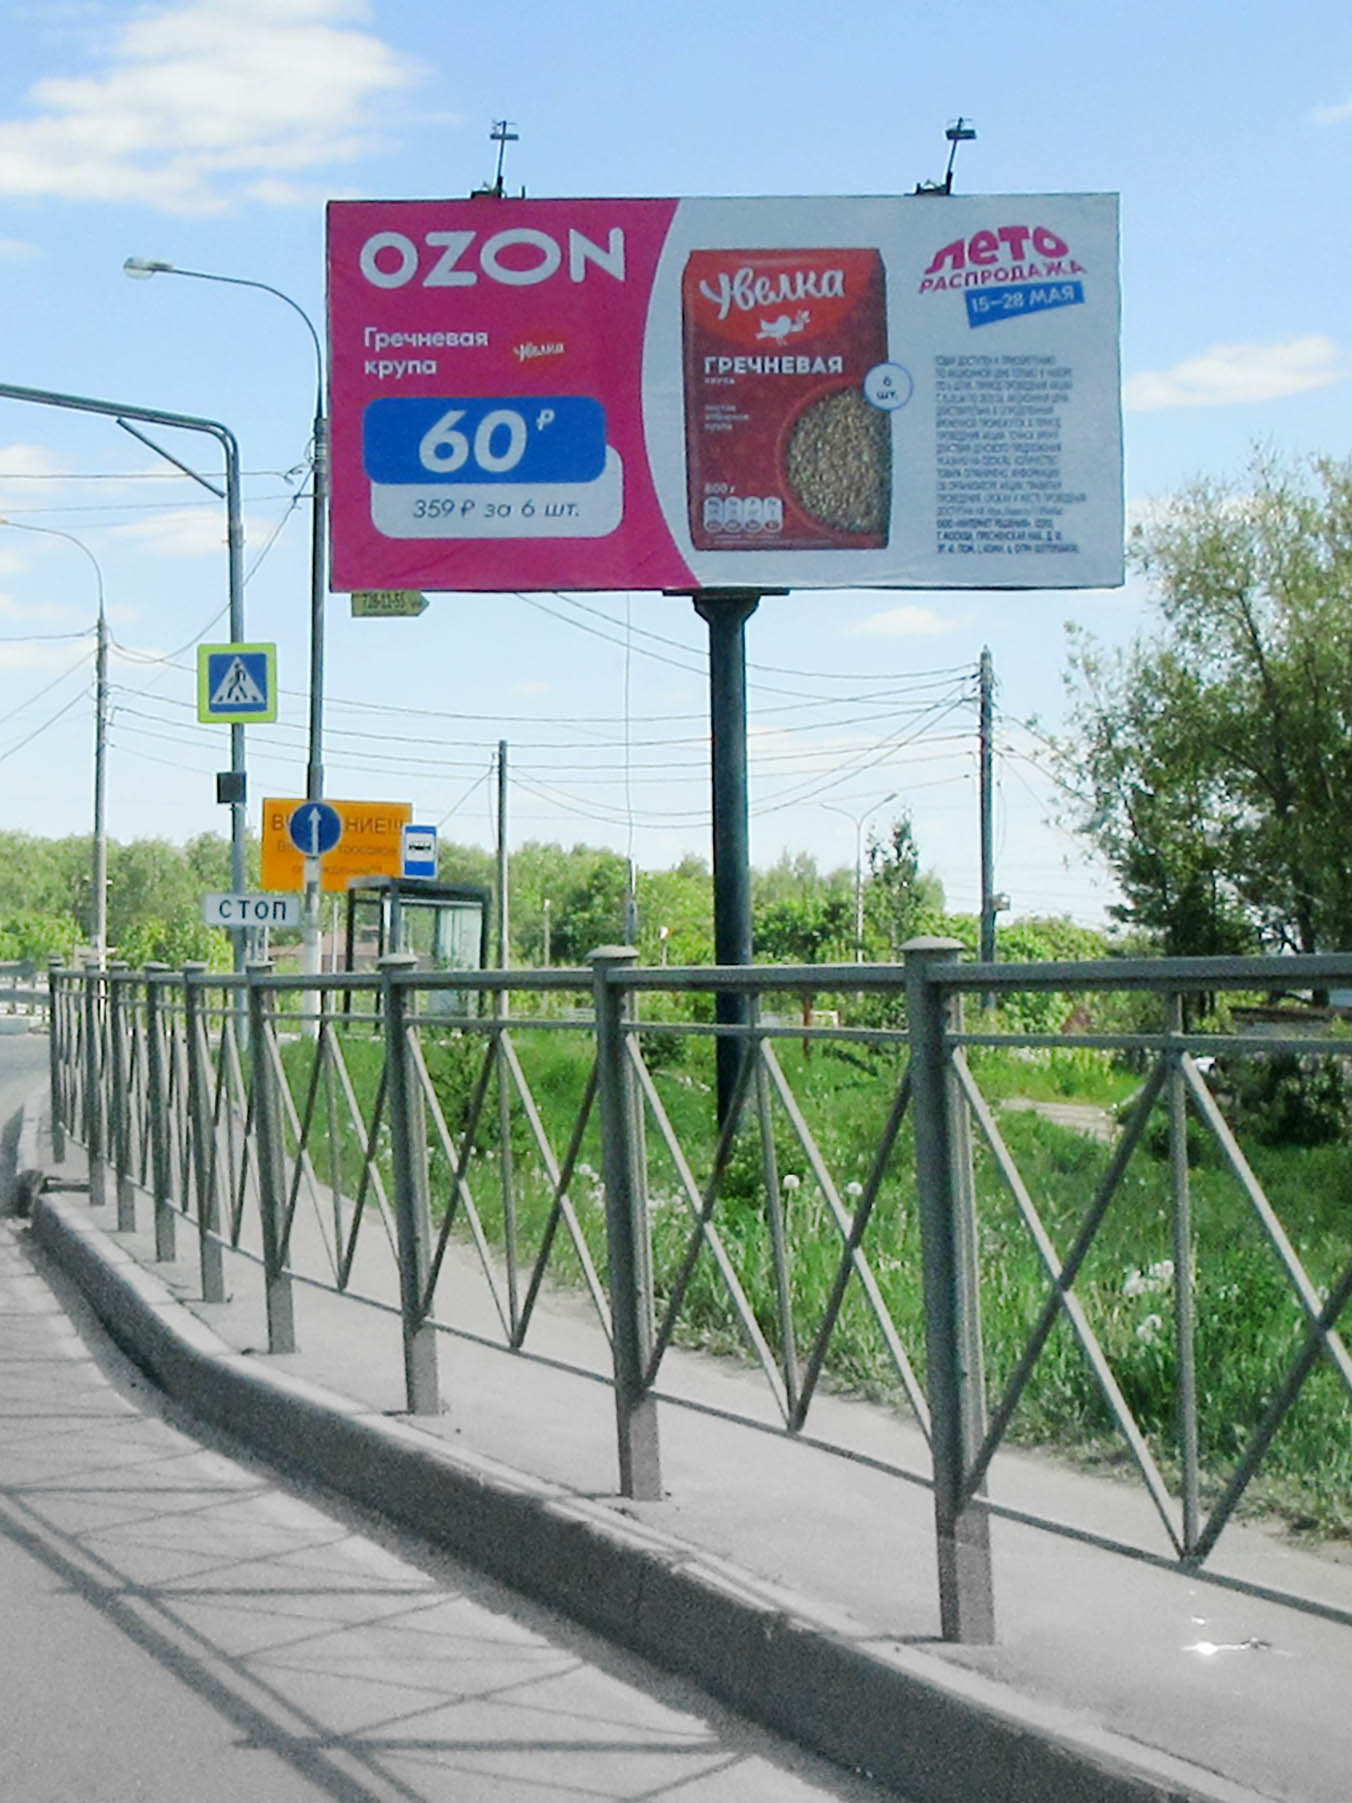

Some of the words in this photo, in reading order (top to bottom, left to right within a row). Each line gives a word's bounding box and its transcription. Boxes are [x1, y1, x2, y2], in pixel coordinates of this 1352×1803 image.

[359, 226, 626, 289] OZON
[1029, 284, 1076, 306] МАЯ
[363, 327, 489, 352] Гречневая
[363, 360, 437, 379] крупа
[704, 355, 844, 375] ГРЕЧНЕВАЯ
[882, 375, 893, 387] 6
[484, 503, 512, 518] за
[520, 500, 536, 517] 6
[544, 502, 580, 518] шт.
[218, 899, 287, 921] СТОП
